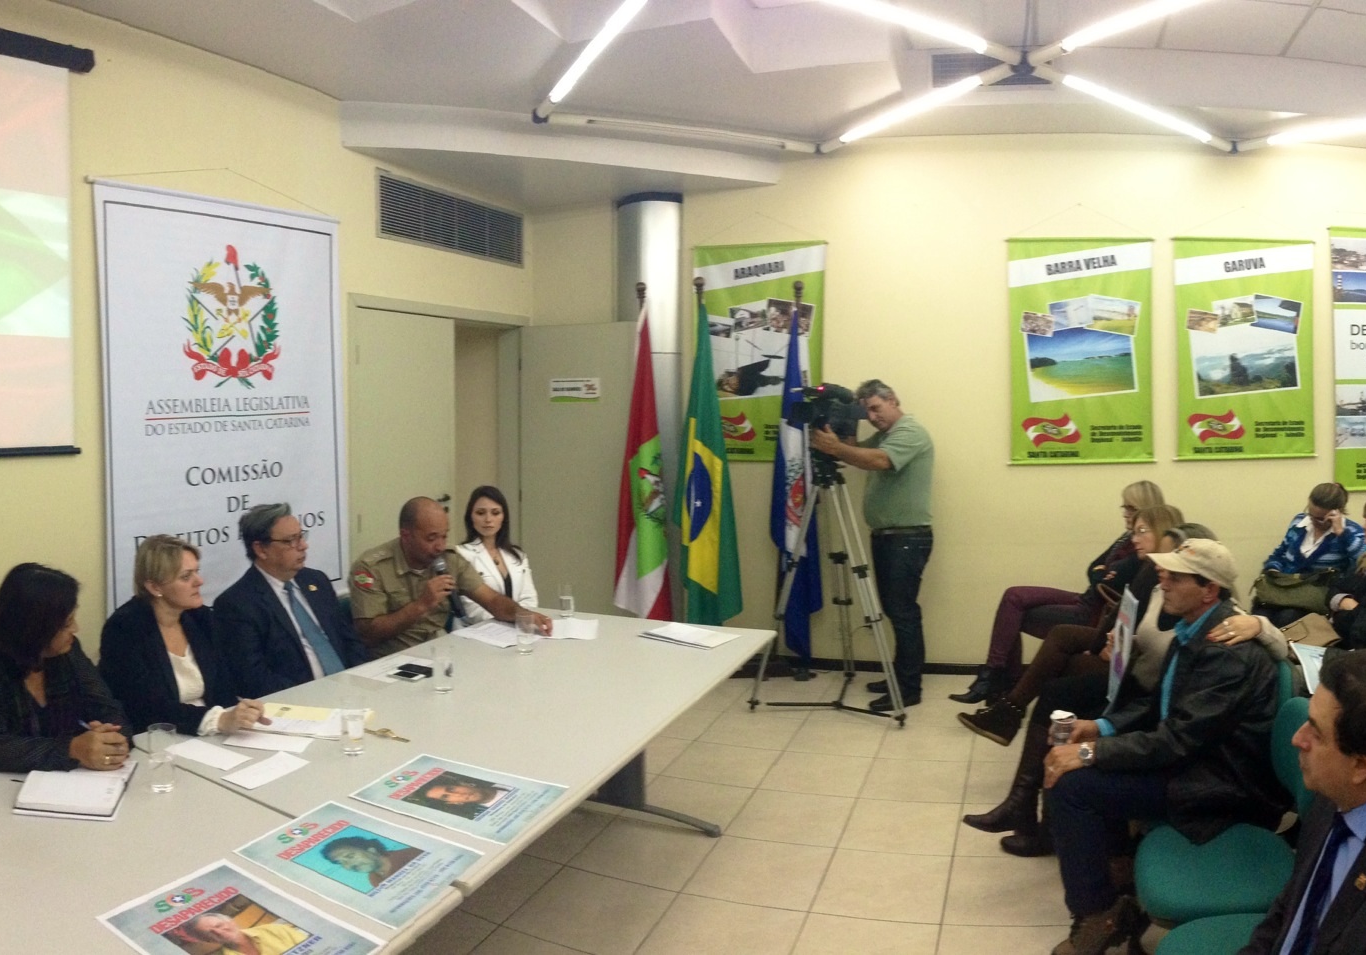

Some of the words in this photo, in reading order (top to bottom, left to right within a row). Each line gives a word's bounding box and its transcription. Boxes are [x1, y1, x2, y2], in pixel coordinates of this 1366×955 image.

[733, 260, 785, 281] ARAQUARI
[1045, 259, 1083, 276] BARRA
[1083, 254, 1117, 271] VELHA
[1224, 257, 1266, 274] GARUVA
[145, 397, 232, 415] ASSEMBLEIA
[235, 395, 310, 412] LEGISLATIVA
[144, 424, 165, 437] DO
[167, 421, 212, 435] ESTADO
[215, 420, 228, 432] DE
[231, 418, 264, 432] SANTA
[265, 416, 311, 430] CATARINA
[185, 459, 283, 487] COMISSÃO
[226, 494, 250, 513] DE
[276, 821, 319, 844] SOS
[154, 886, 205, 913] SOS
[148, 886, 240, 935] DESAPARECIDO
